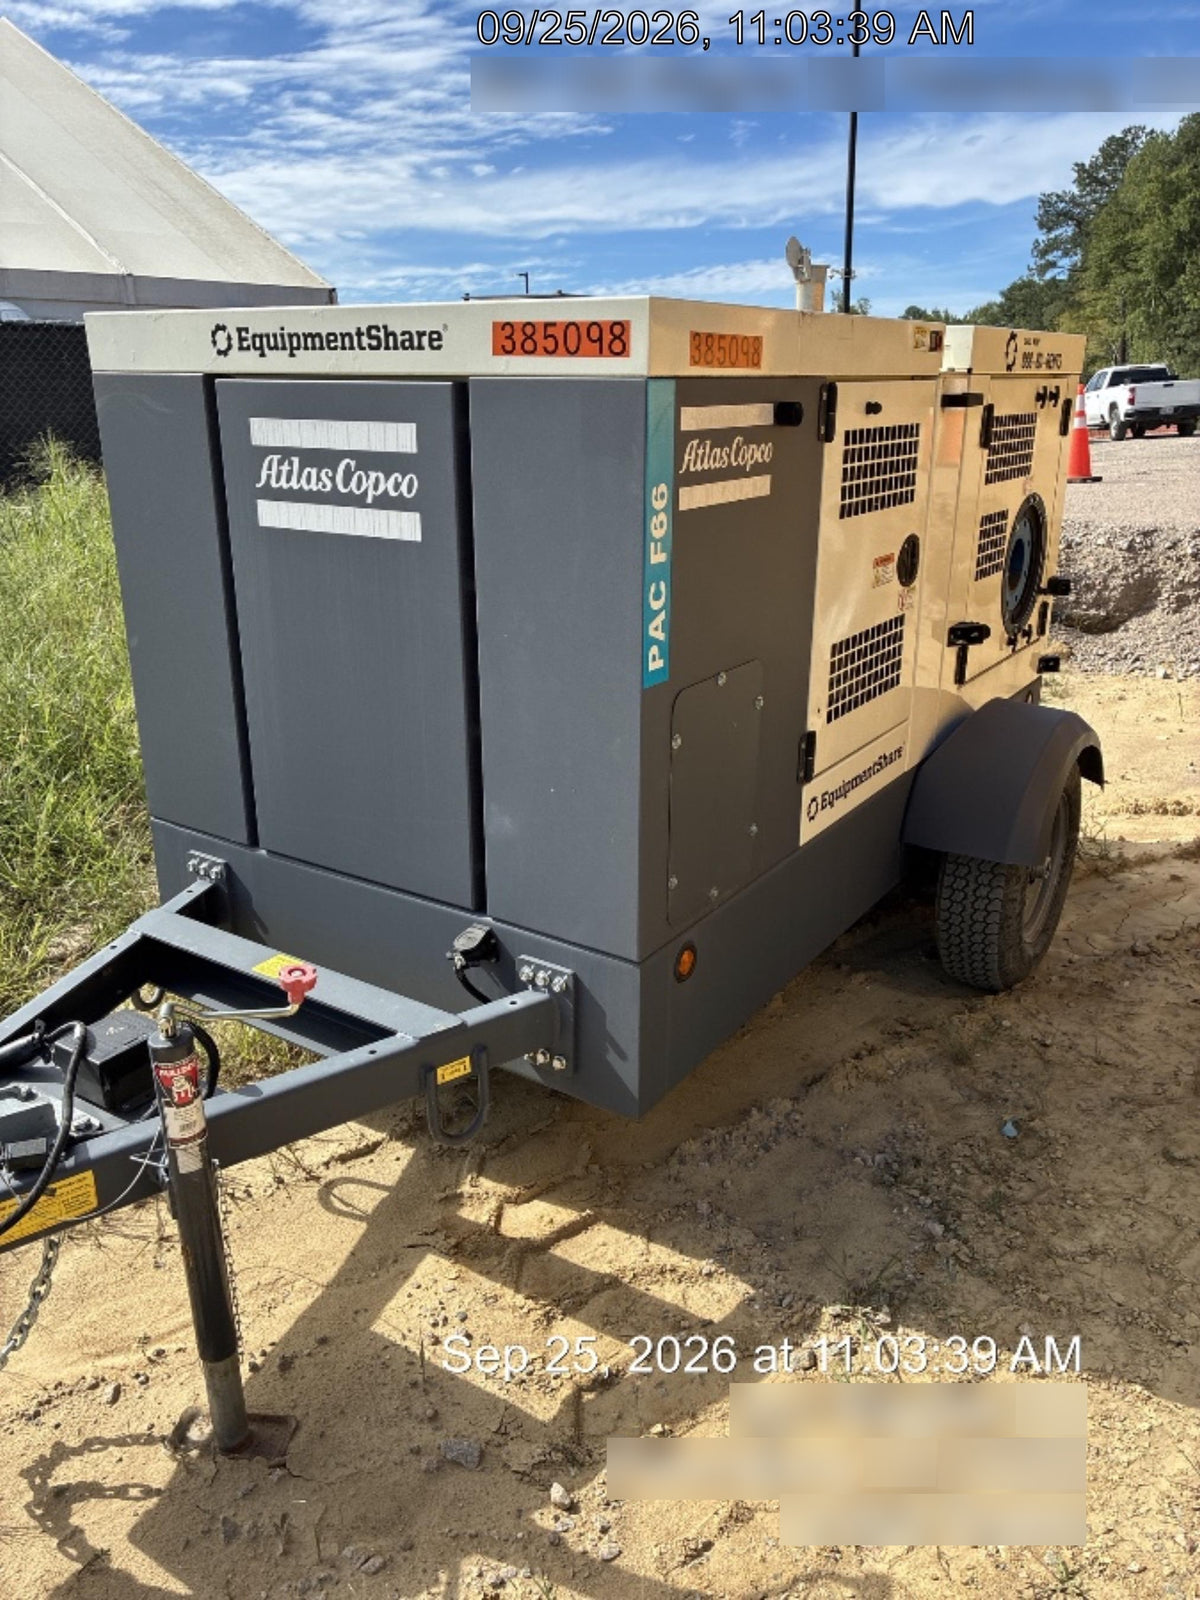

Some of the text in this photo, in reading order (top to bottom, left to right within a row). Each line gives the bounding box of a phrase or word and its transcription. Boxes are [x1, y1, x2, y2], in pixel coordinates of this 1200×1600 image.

[236, 324, 443, 357] EquipmentShare
[500, 321, 627, 356] 385098
[692, 332, 760, 367] 385098
[648, 482, 668, 672] PAC F66
